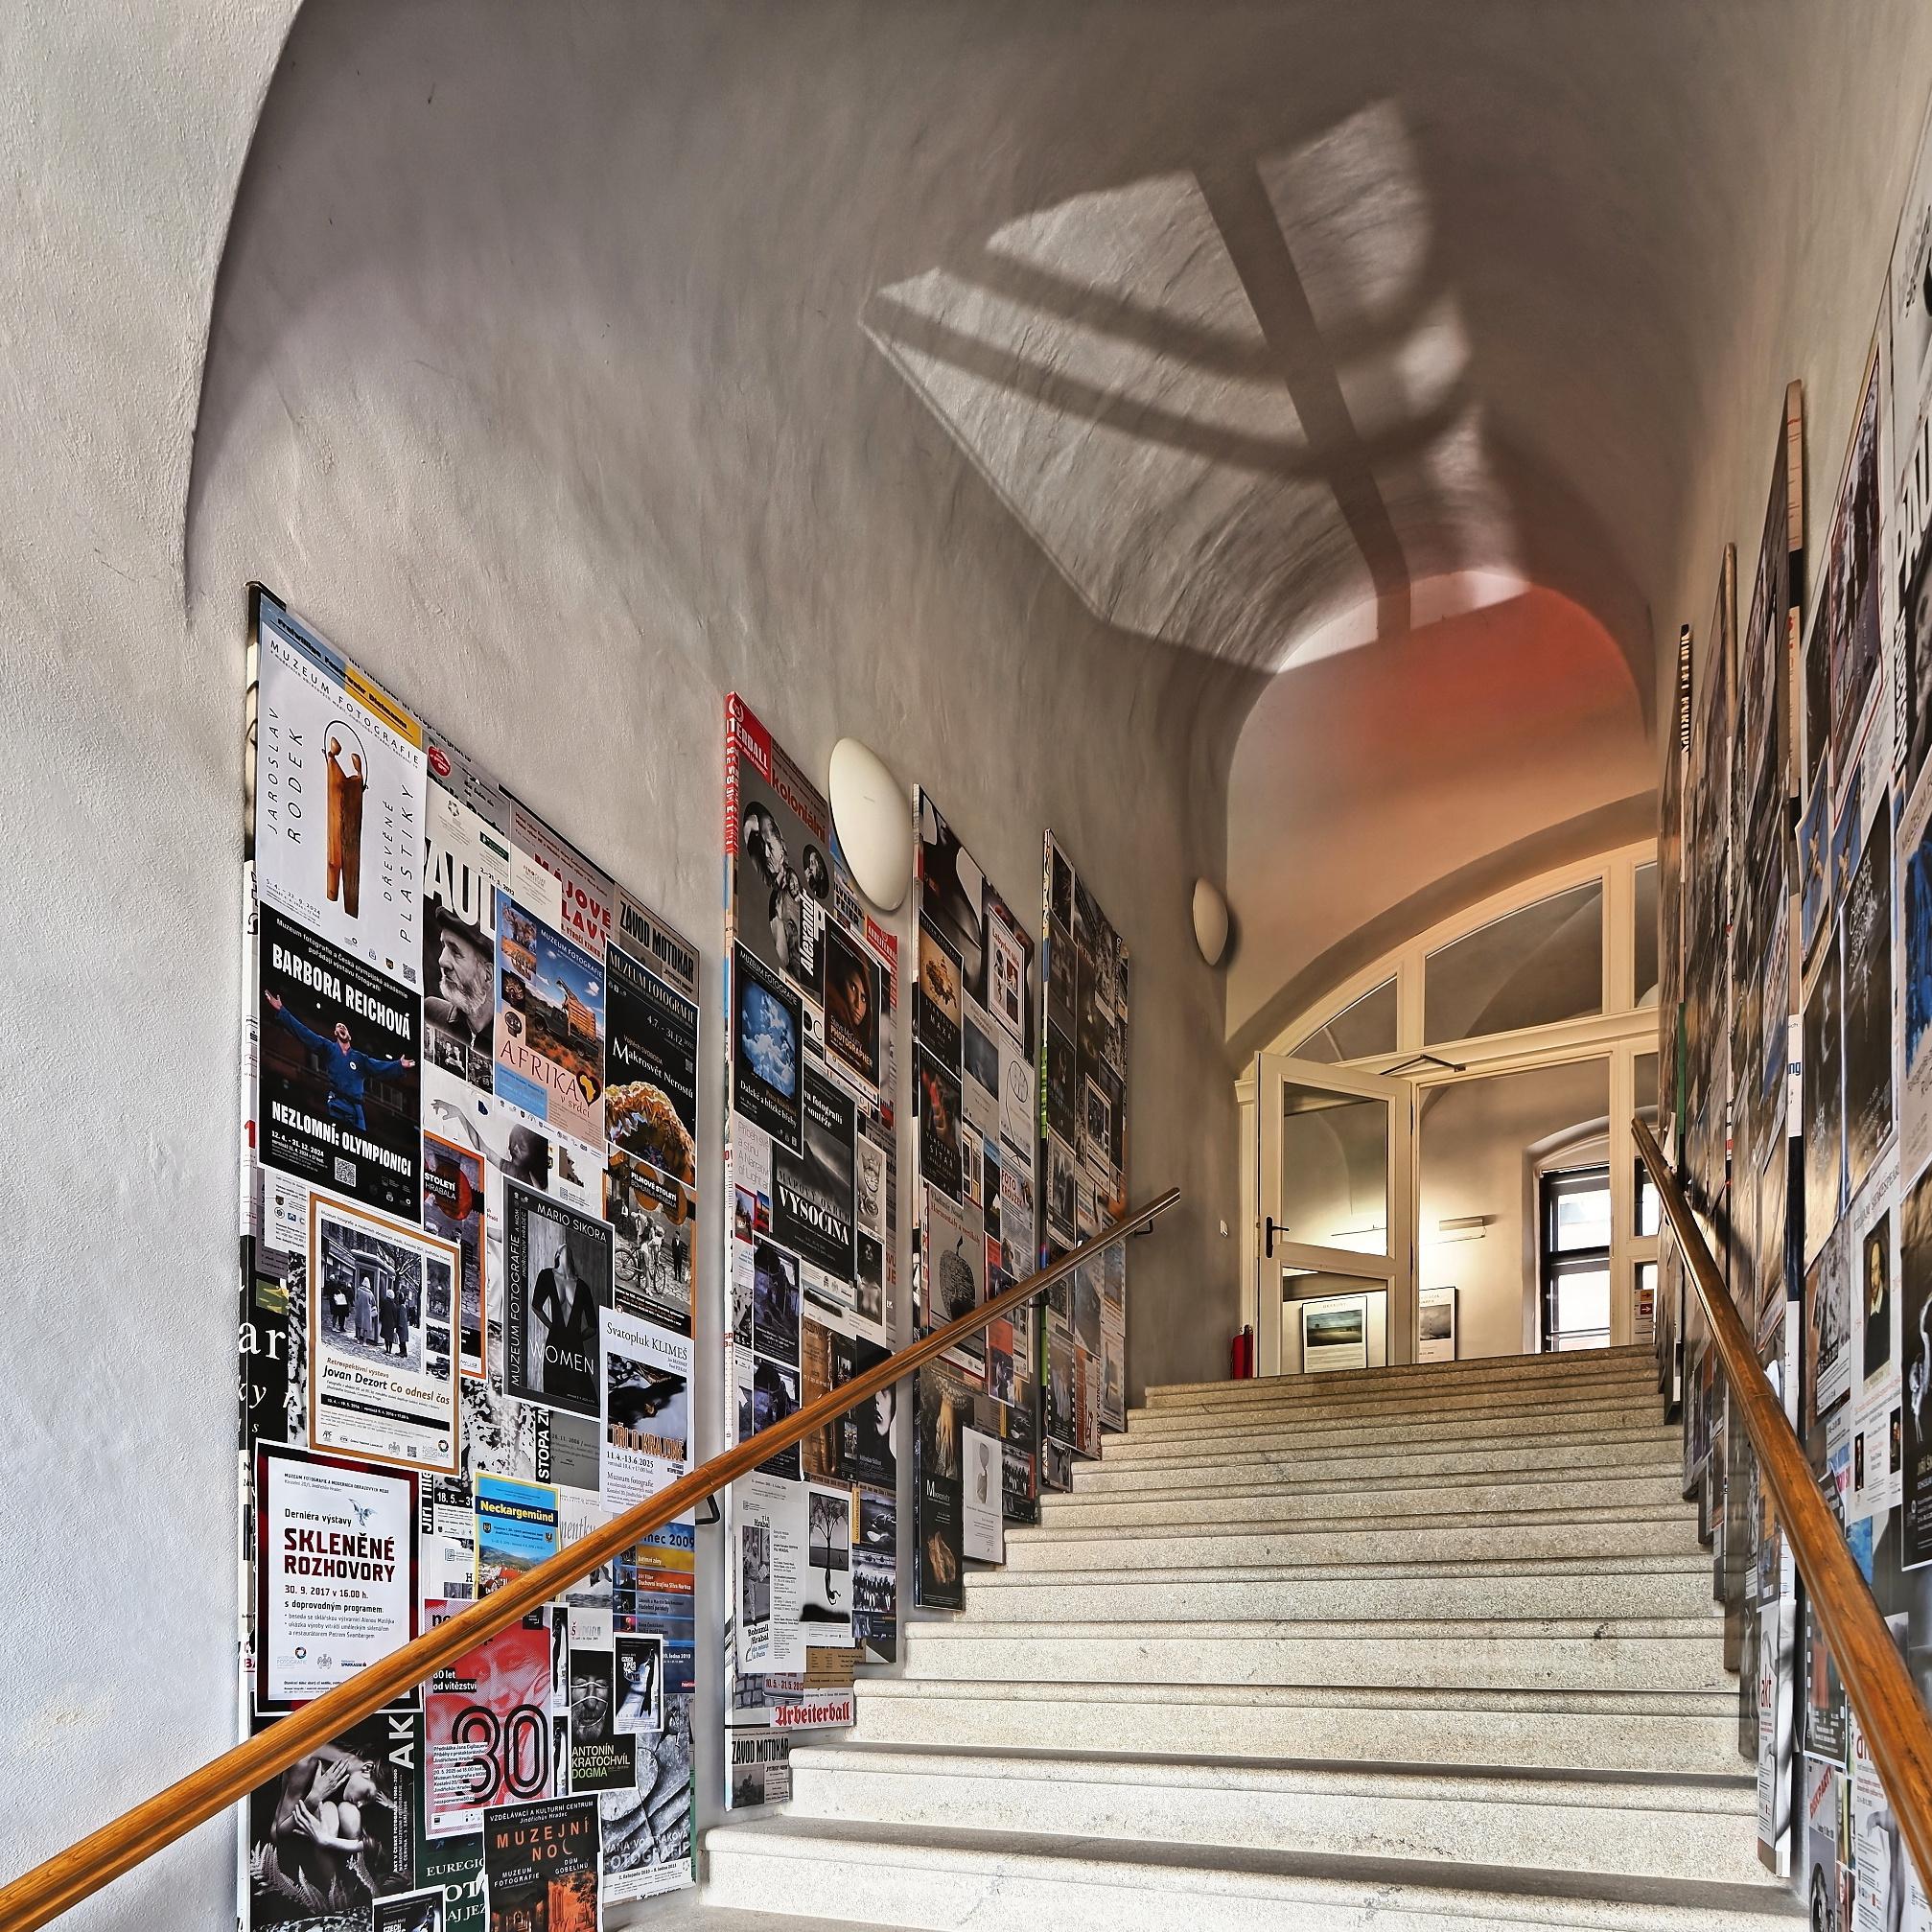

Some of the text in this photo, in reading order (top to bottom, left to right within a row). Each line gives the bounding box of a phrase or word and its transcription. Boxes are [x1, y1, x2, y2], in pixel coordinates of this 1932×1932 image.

[270, 640, 330, 695] MUZEUM
[338, 695, 419, 765] FOTOGRAFIE
[267, 707, 279, 835] JAROSLAV
[287, 728, 304, 845] RODEK
[381, 800, 394, 902] DŘEVĚNÉ
[399, 783, 414, 943] PLASTIKY
[276, 918, 302, 938] Muzeum
[619, 899, 694, 985] ZÁVOD MOTOKÁR
[540, 929, 603, 978] MUZEUM FOTOGRAFIE
[272, 943, 410, 1040] BARBORA REICHOVÁ
[610, 950, 694, 1024] MUZEUM FOTOGRAFIE
[613, 1036, 663, 1079] Makrosvět
[830, 1024, 873, 1068] PHOTOGRAPHER
[500, 1039, 580, 1102] AFRIKA
[568, 1100, 591, 1118] srdci
[271, 1101, 339, 1147] NEZLOMNÍ:
[341, 1131, 411, 1177] OLYMPIONICI
[424, 1172, 456, 1192] STOLETÍ
[424, 1181, 456, 1200] HRABALA
[631, 1172, 677, 1201] FILMOVÉ STOLETÍ
[537, 1203, 607, 1243] MARIO SIKORA
[779, 1185, 850, 1246] VYSOČINA
[510, 1234, 520, 1386] MUZEUM FOTOGRAFIE
[607, 1321, 687, 1361] Svatopluk KLIMEŠ
[327, 1358, 367, 1373] Retrospektivní
[529, 1339, 594, 1376] WOMEN
[322, 1365, 351, 1381] Jovan
[355, 1373, 387, 1390] Dezort
[390, 1383, 403, 1393] Co
[406, 1386, 433, 1401] odnesl
[435, 1393, 451, 1405] čas
[537, 1430, 550, 1479] STOPA
[437, 1492, 447, 1502] 18.
[285, 1508, 352, 1527] Derniéra výstavy
[479, 1501, 554, 1523] Neckargemünd
[284, 1527, 395, 1561] SKLENĚNÉ
[669, 1533, 695, 1548] 2009
[284, 1555, 396, 1583] ROZHOVORY
[284, 1585, 298, 1594] 30.
[300, 1587, 308, 1595] 9.
[310, 1587, 330, 1597] 2017
[339, 1589, 361, 1599] 16.00
[361, 1591, 369, 1599] h.
[291, 1599, 342, 1612] doprovodným
[433, 1680, 477, 1692] od vítězství
[446, 1669, 456, 1679] let
[775, 1701, 850, 1727] Arbeiterball
[451, 1703, 549, 1805] 80
[571, 1754, 631, 1768] KRATOCHVÍL
[572, 1742, 615, 1757] ANTONÍN
[732, 1737, 789, 1764] ZÁVOD MOTOKÁR
[572, 1768, 608, 1780] DOGMA
[490, 1808, 529, 1822] VZDĚLÁVACÍ
[535, 1804, 566, 1814] KULTURNÍ
[567, 1801, 594, 1811] CENTRUM
[520, 1811, 568, 1824] Jindřichův Hradec
[497, 1816, 590, 1849] MUZEJNÍ
[501, 1867, 532, 1878] MUZEUM
[555, 1858, 589, 1874] GOBELÍNŮ
[564, 1857, 578, 1866] DŮM
[494, 1873, 540, 1888] FOTOGRAFIE
